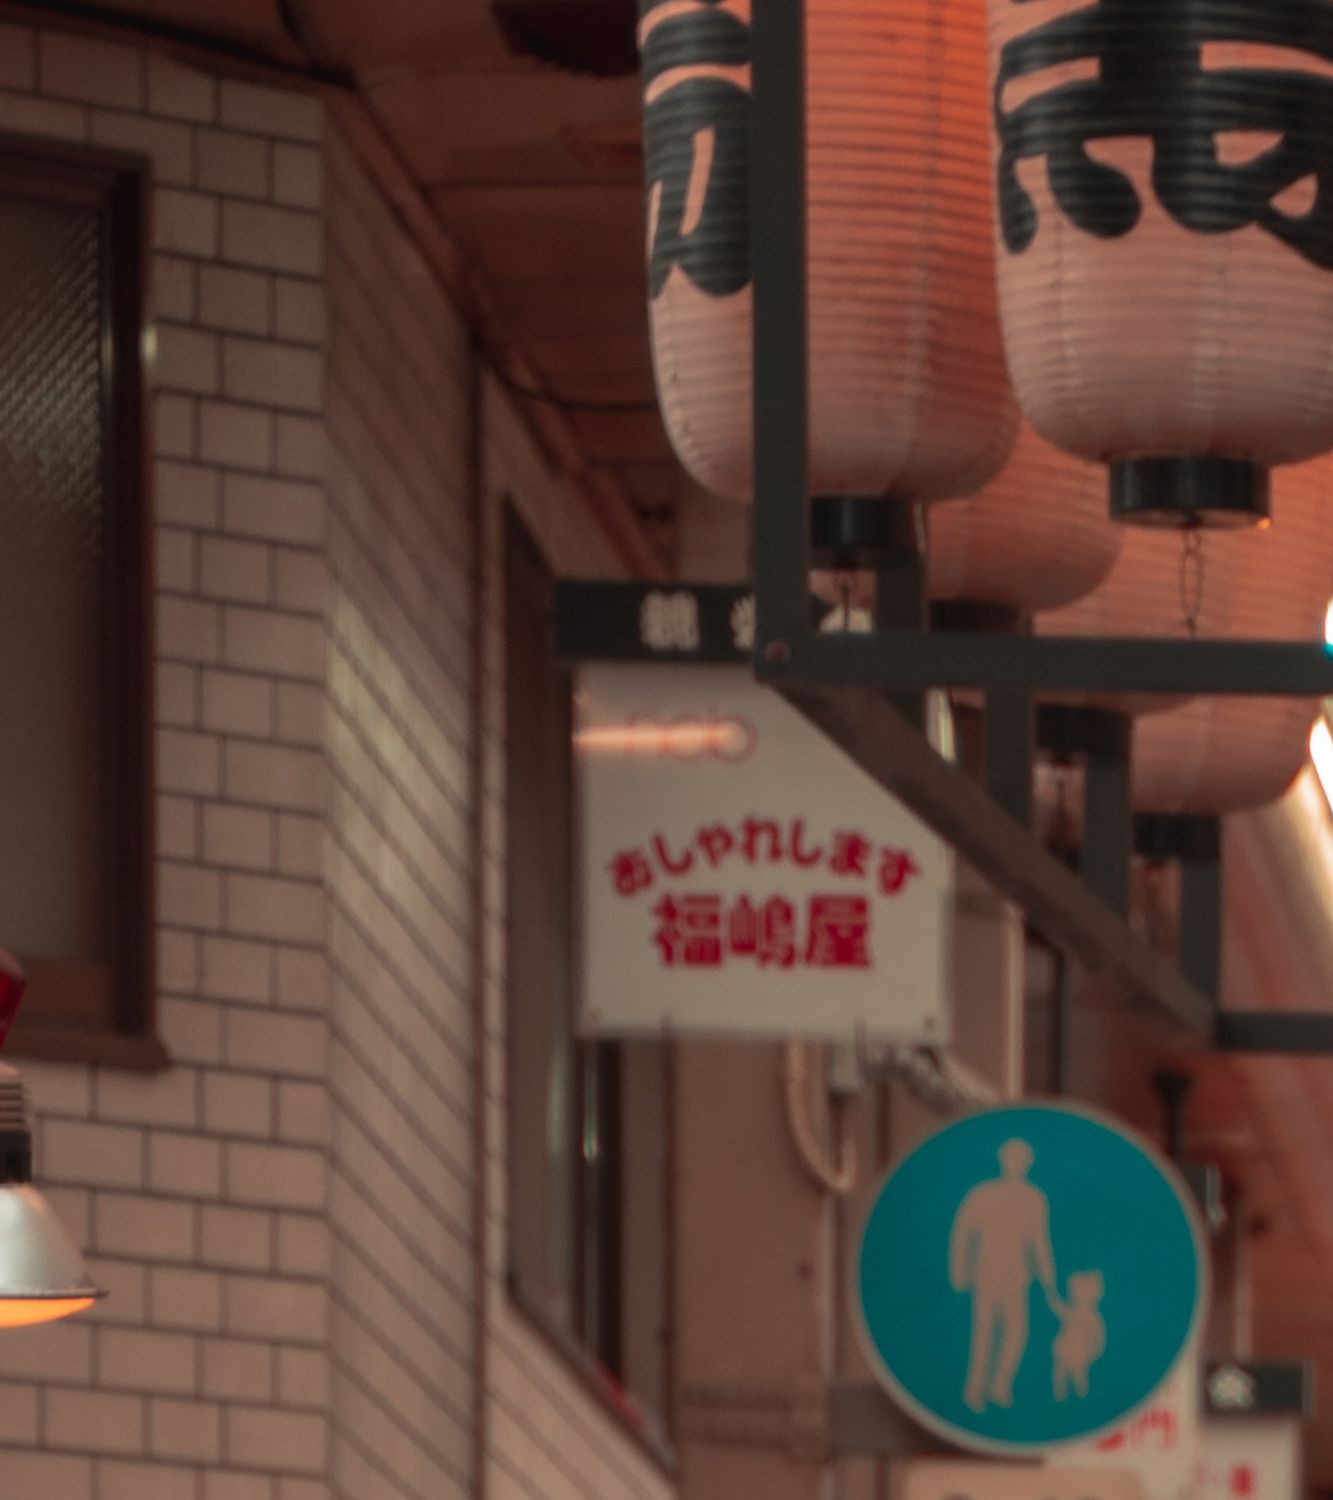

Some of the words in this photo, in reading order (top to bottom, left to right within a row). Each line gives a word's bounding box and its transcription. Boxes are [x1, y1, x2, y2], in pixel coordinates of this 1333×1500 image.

[610, 816, 919, 897] おしゃれします
[652, 894, 872, 968] 福嶋屋
